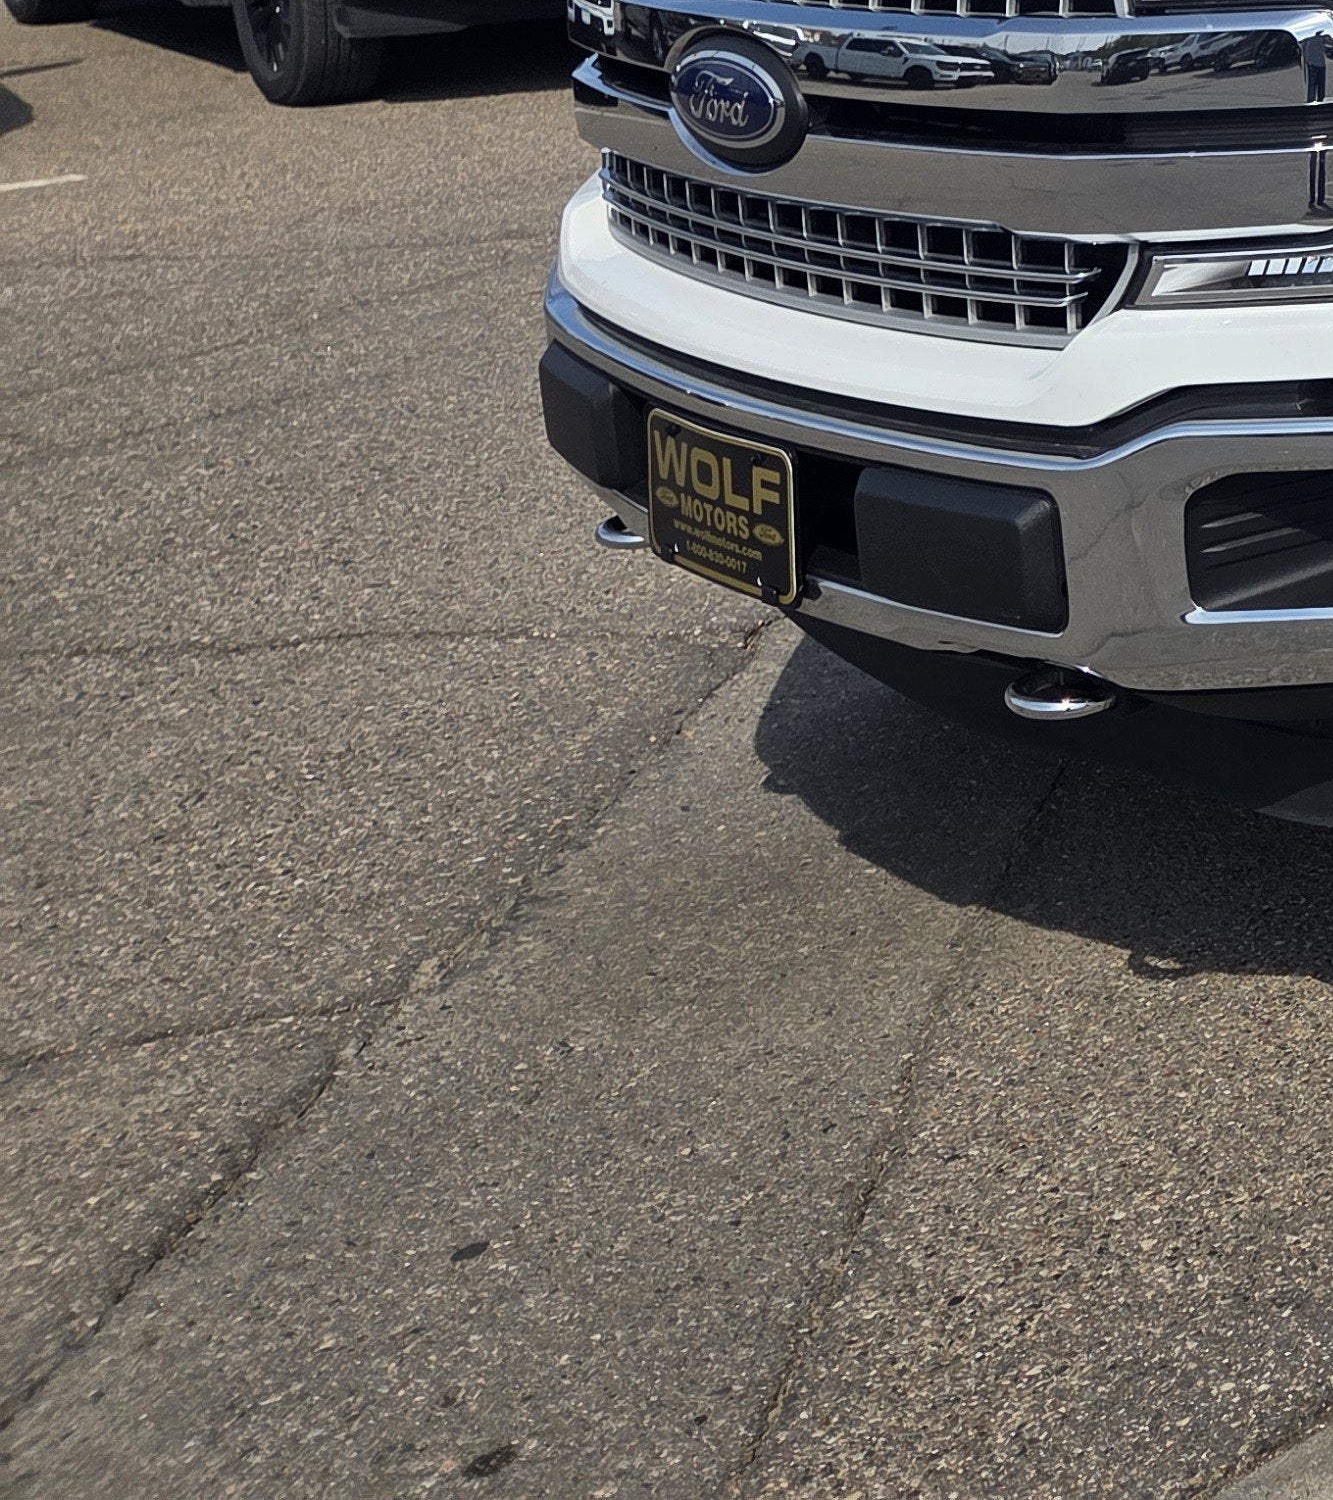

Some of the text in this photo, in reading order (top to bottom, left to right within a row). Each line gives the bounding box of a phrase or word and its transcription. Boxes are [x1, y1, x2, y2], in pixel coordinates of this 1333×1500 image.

[689, 70, 749, 127] Ford
[654, 429, 781, 516] WOLF
[681, 492, 749, 540] MOTORS
